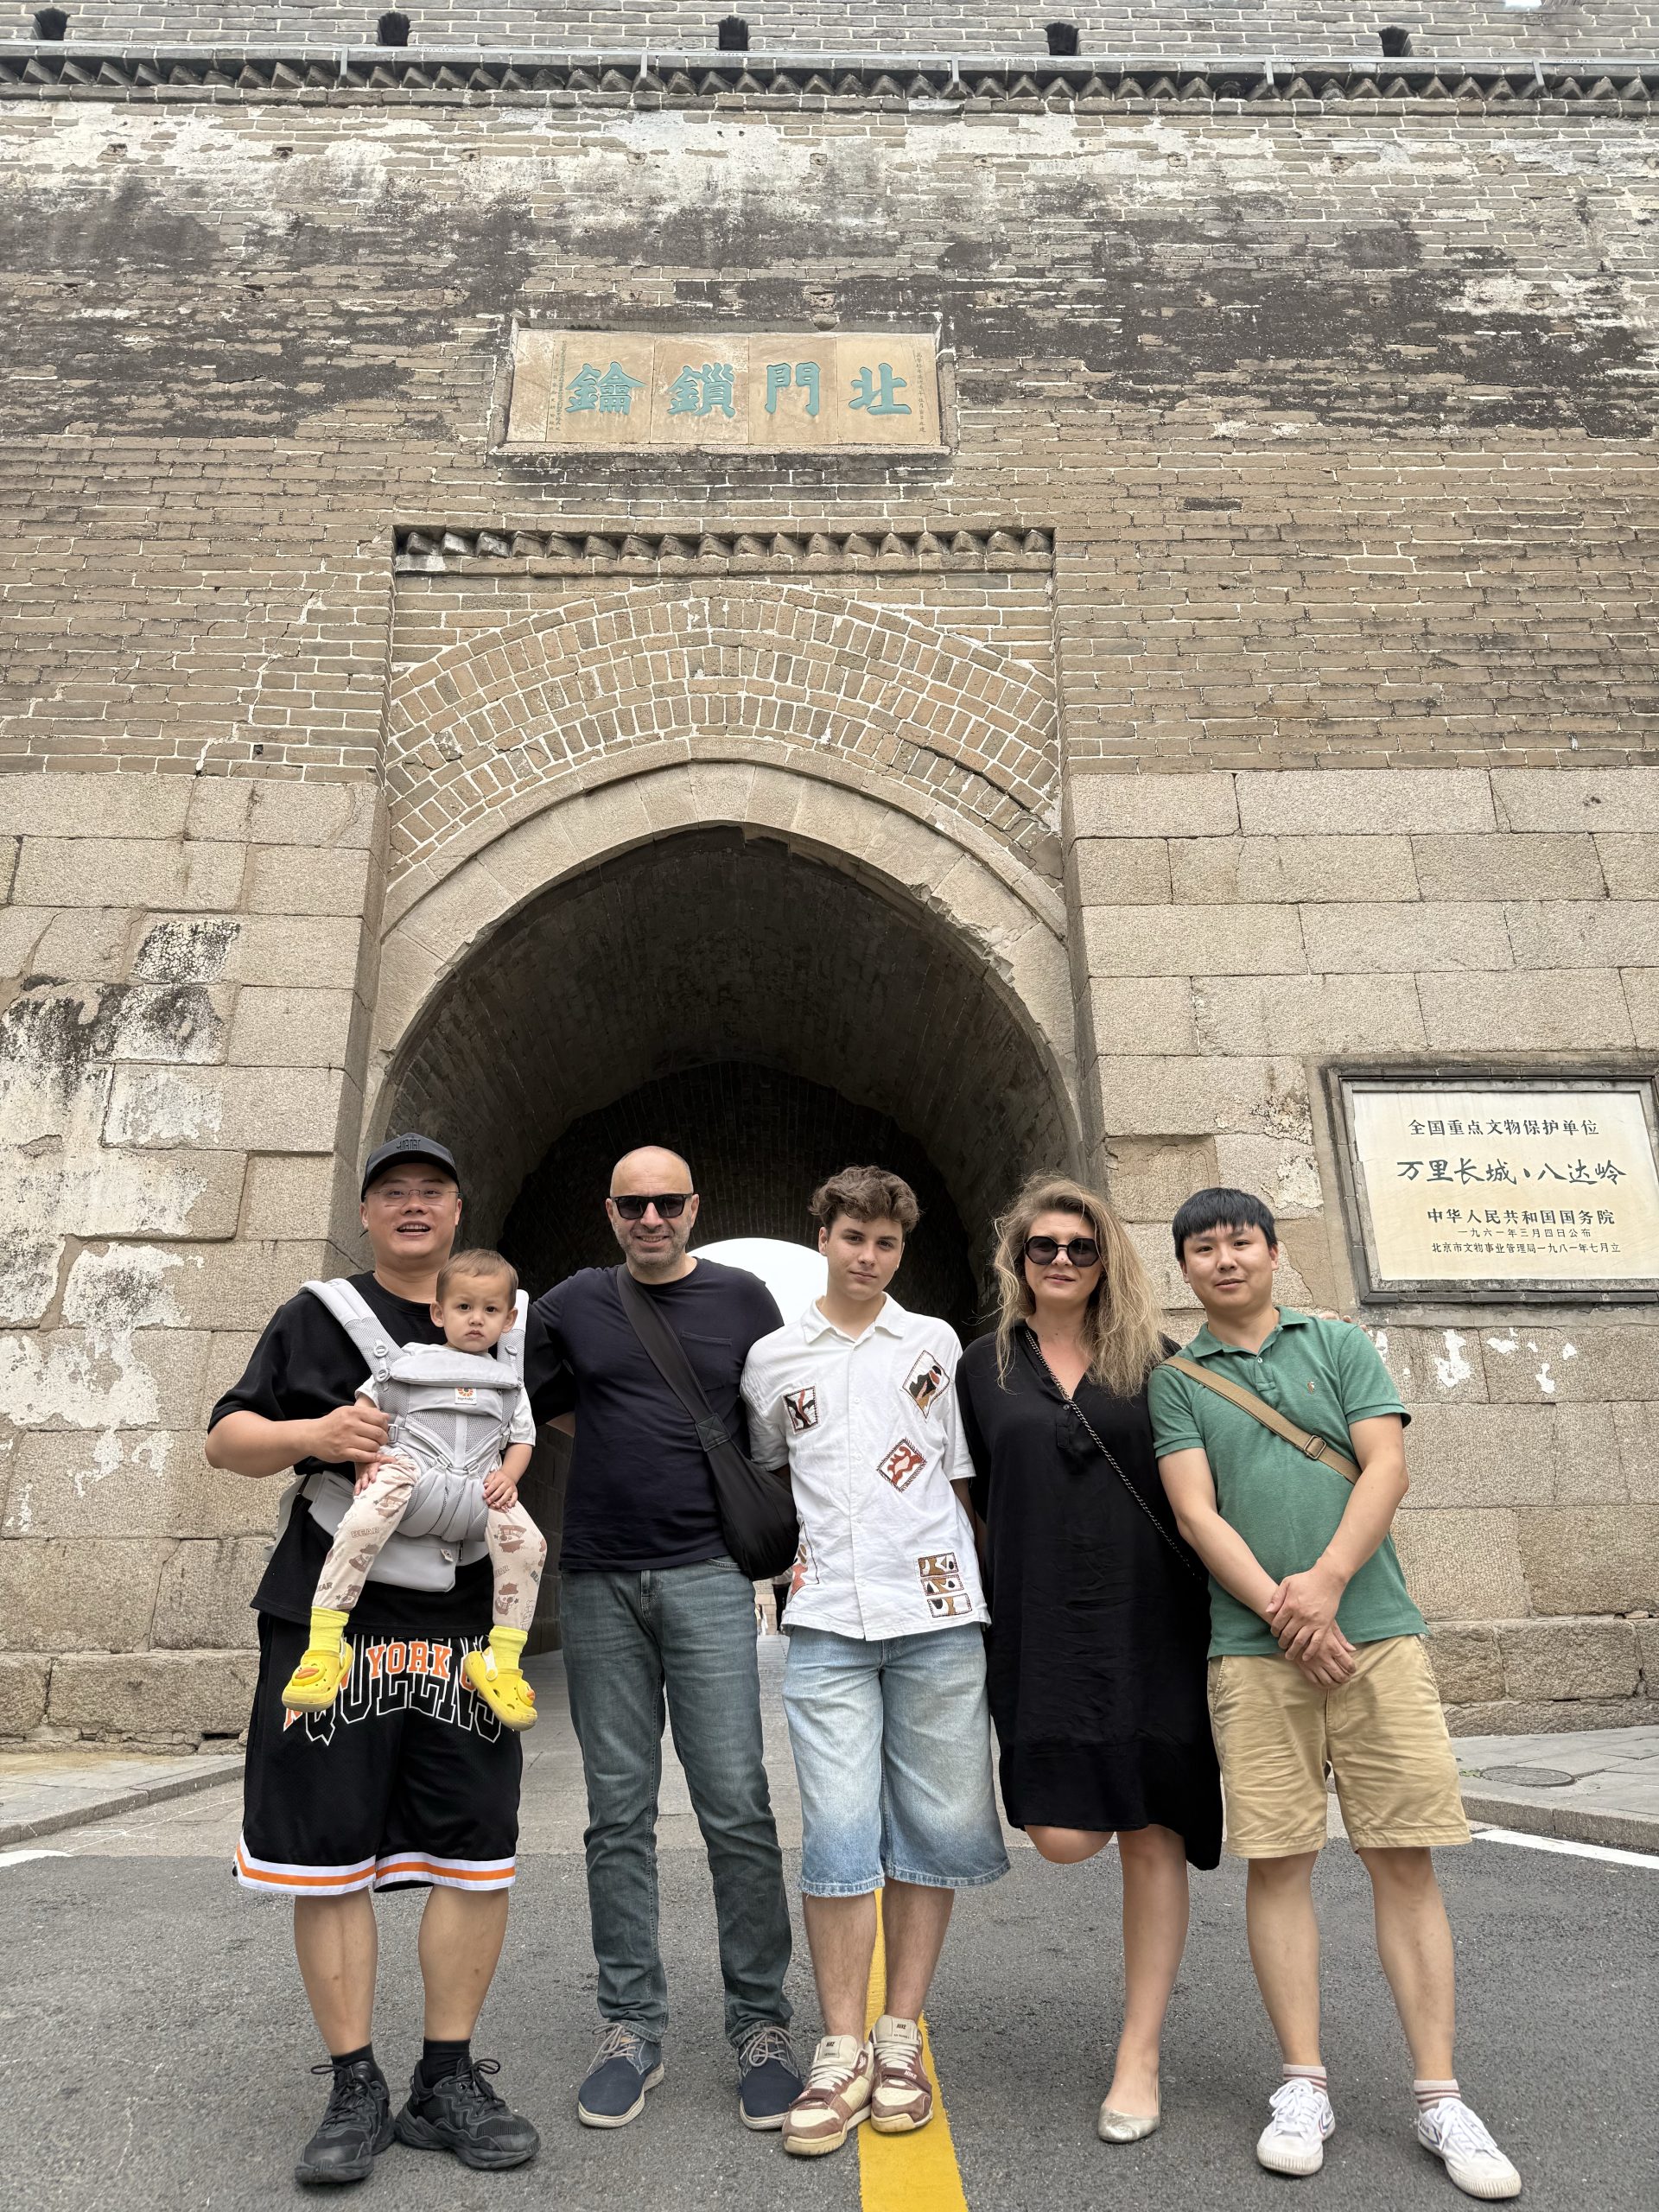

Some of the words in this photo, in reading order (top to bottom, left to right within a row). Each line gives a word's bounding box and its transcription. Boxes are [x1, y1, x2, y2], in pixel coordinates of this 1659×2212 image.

[1408, 1119, 1599, 1136] 全国重点文物保护单位
[1427, 1208, 1615, 1225] 中华人民共和国国务院
[1458, 1228, 1591, 1238] 一九六一年三月四日公布
[1432, 1242, 1621, 1254] 北京市文物事业管理局一九八一年七月立
[351, 1527, 380, 1538] BEAR
[365, 1641, 453, 1681] YORK
